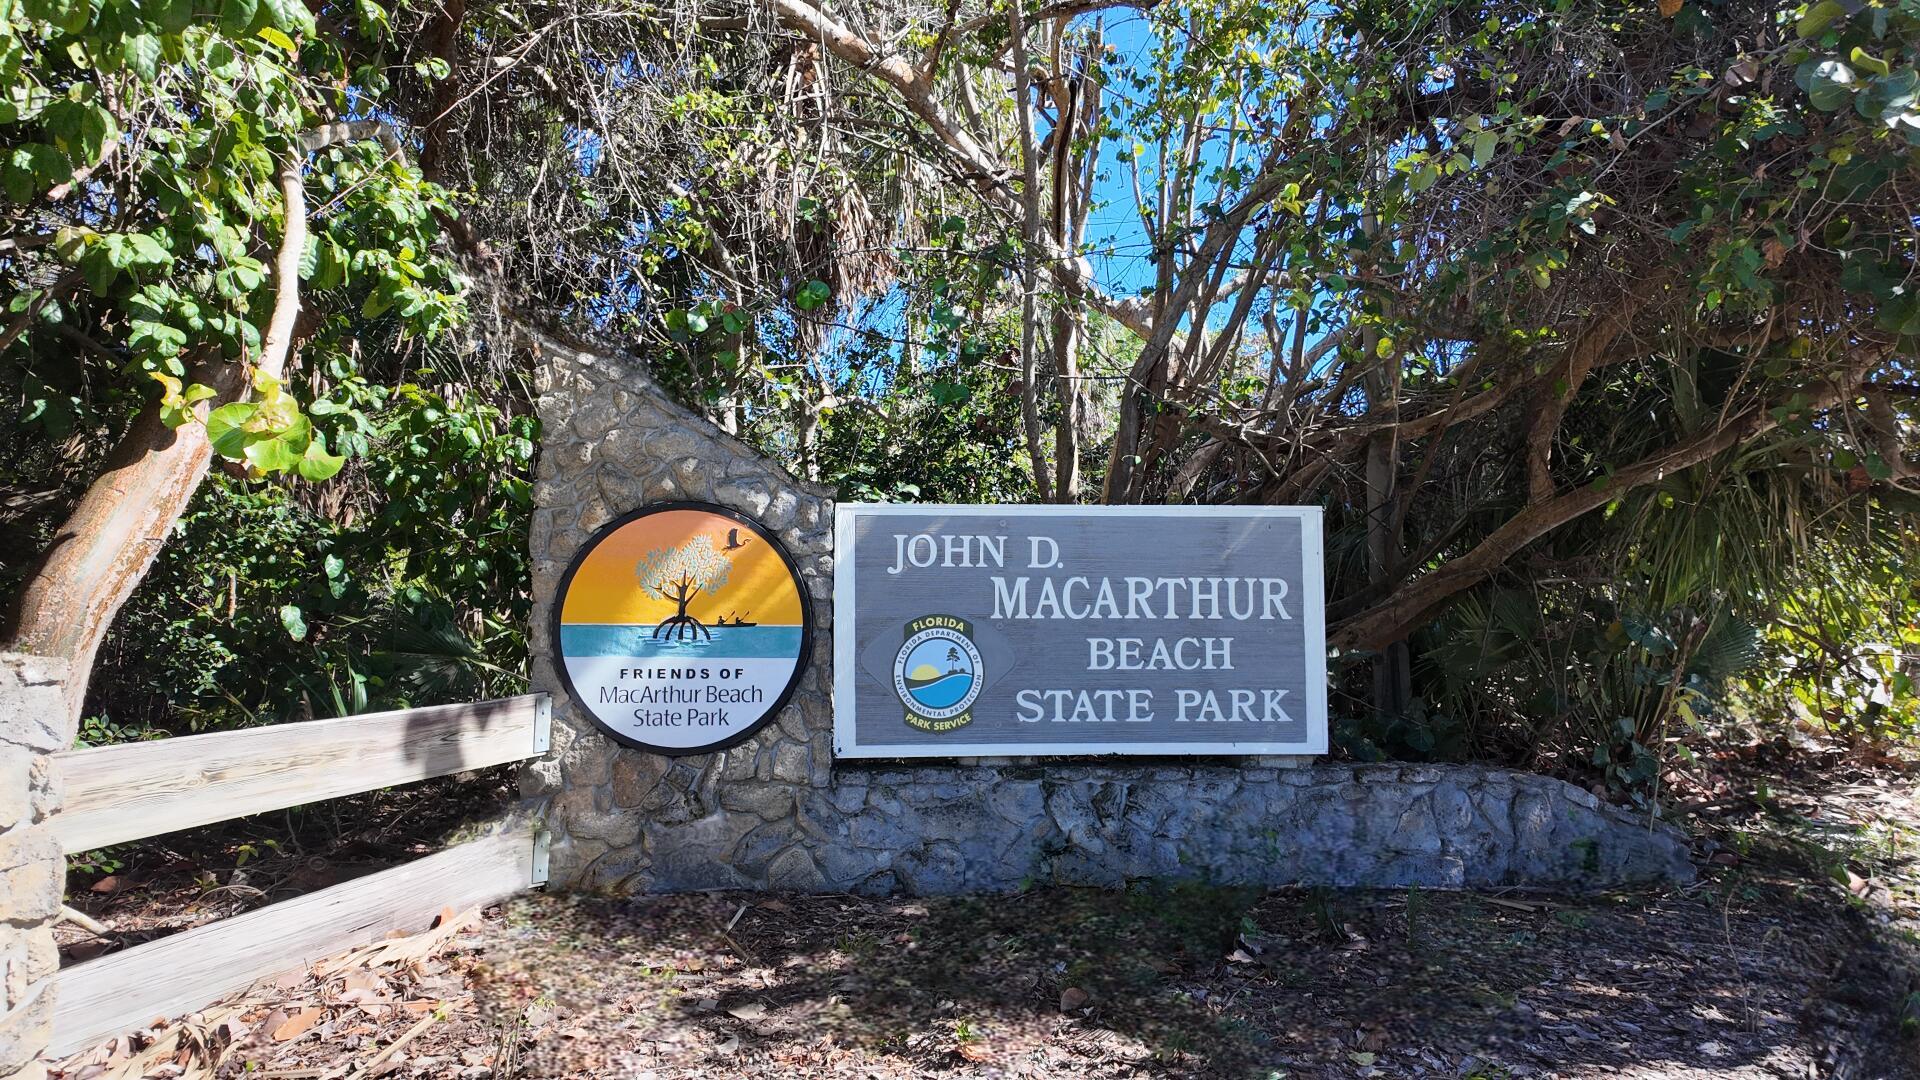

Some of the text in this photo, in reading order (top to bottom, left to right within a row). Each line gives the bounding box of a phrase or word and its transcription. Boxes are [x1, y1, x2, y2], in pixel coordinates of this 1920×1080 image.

[887, 534, 1064, 575] JOHN D.
[990, 575, 1292, 620] MACARTHUR
[912, 617, 965, 632] FLORIDA
[897, 630, 980, 665] FLORIDA DEPARTMENT OF
[1086, 637, 1235, 670] BEACH
[620, 668, 744, 679] FRIENDS OF
[599, 685, 763, 704] MacArthur Beach
[896, 674, 982, 717] ENVIRONMENTAL PROTECTION
[1016, 688, 1293, 723] STATE PARK
[633, 708, 729, 727] State Park
[905, 713, 972, 731] PARK SERVICE
